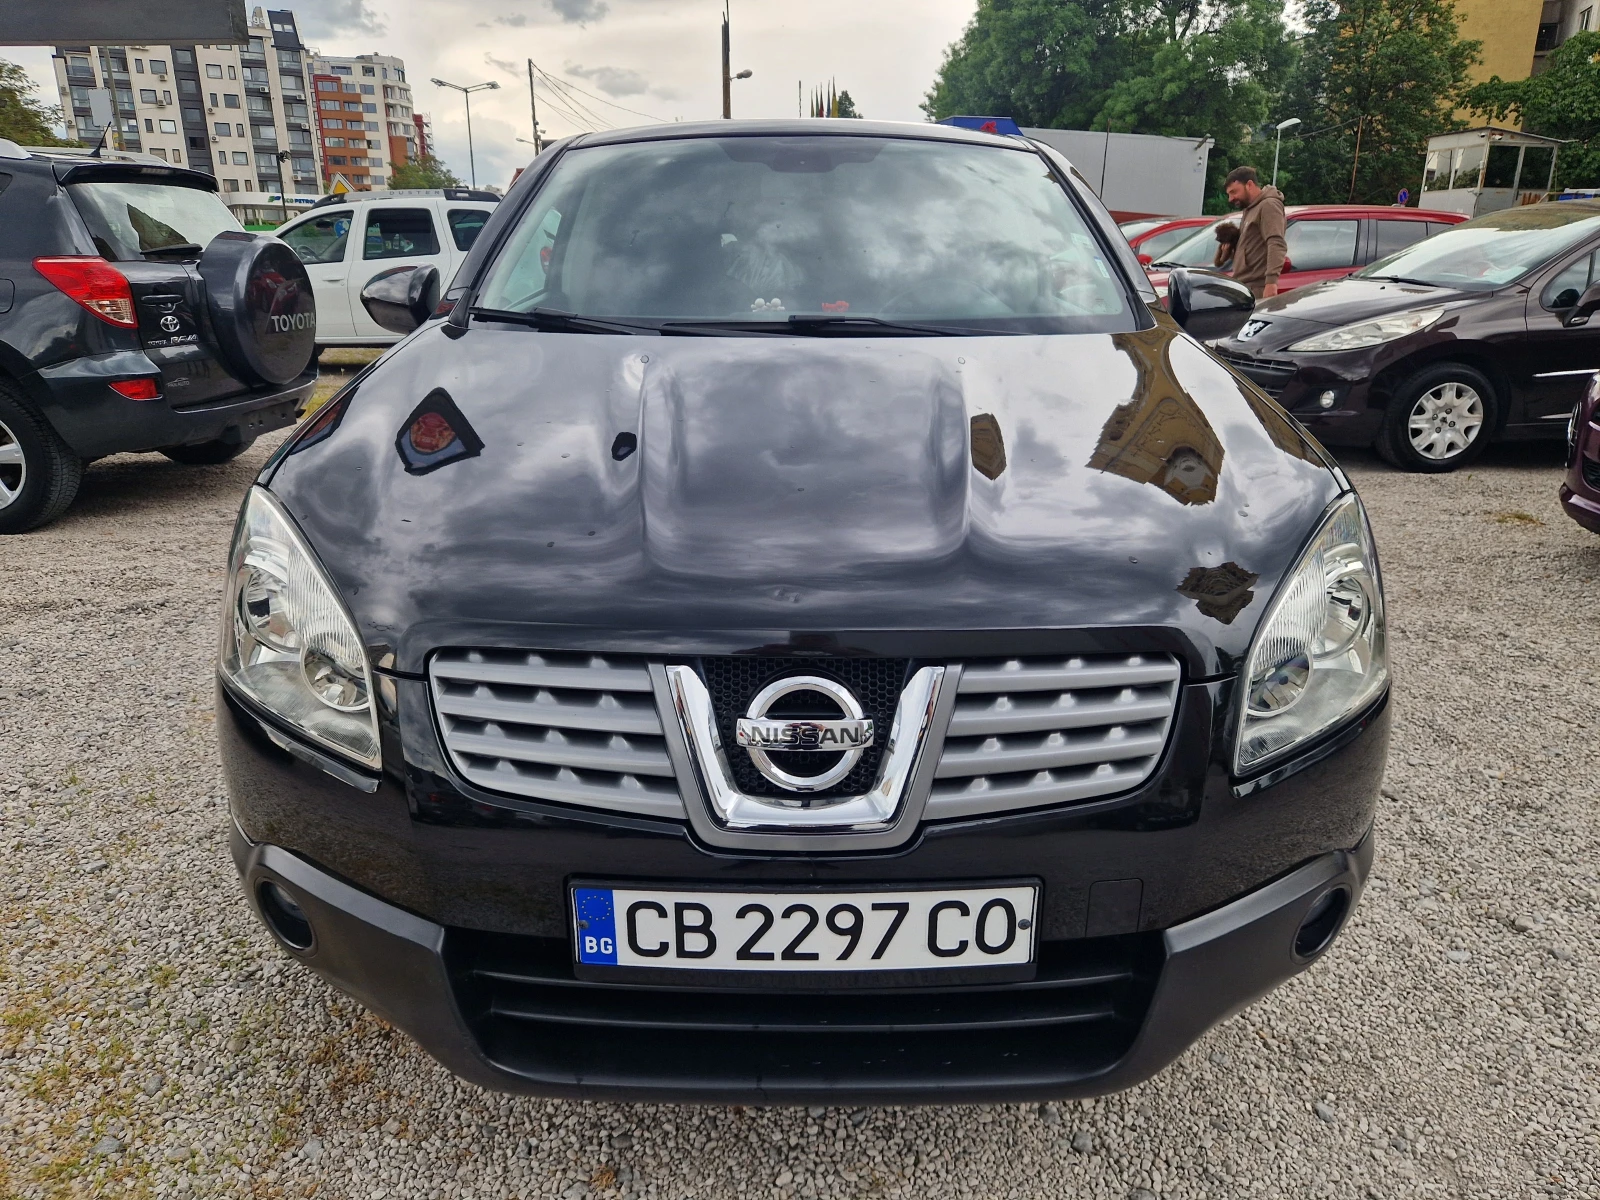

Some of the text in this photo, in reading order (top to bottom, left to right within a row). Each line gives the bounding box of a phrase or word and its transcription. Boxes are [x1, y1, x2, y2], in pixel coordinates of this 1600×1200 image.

[271, 312, 316, 332] TOYOTA
[751, 726, 859, 745] NISSAN
[626, 897, 1017, 961] CB 2297 CO
[585, 936, 613, 955] BG
